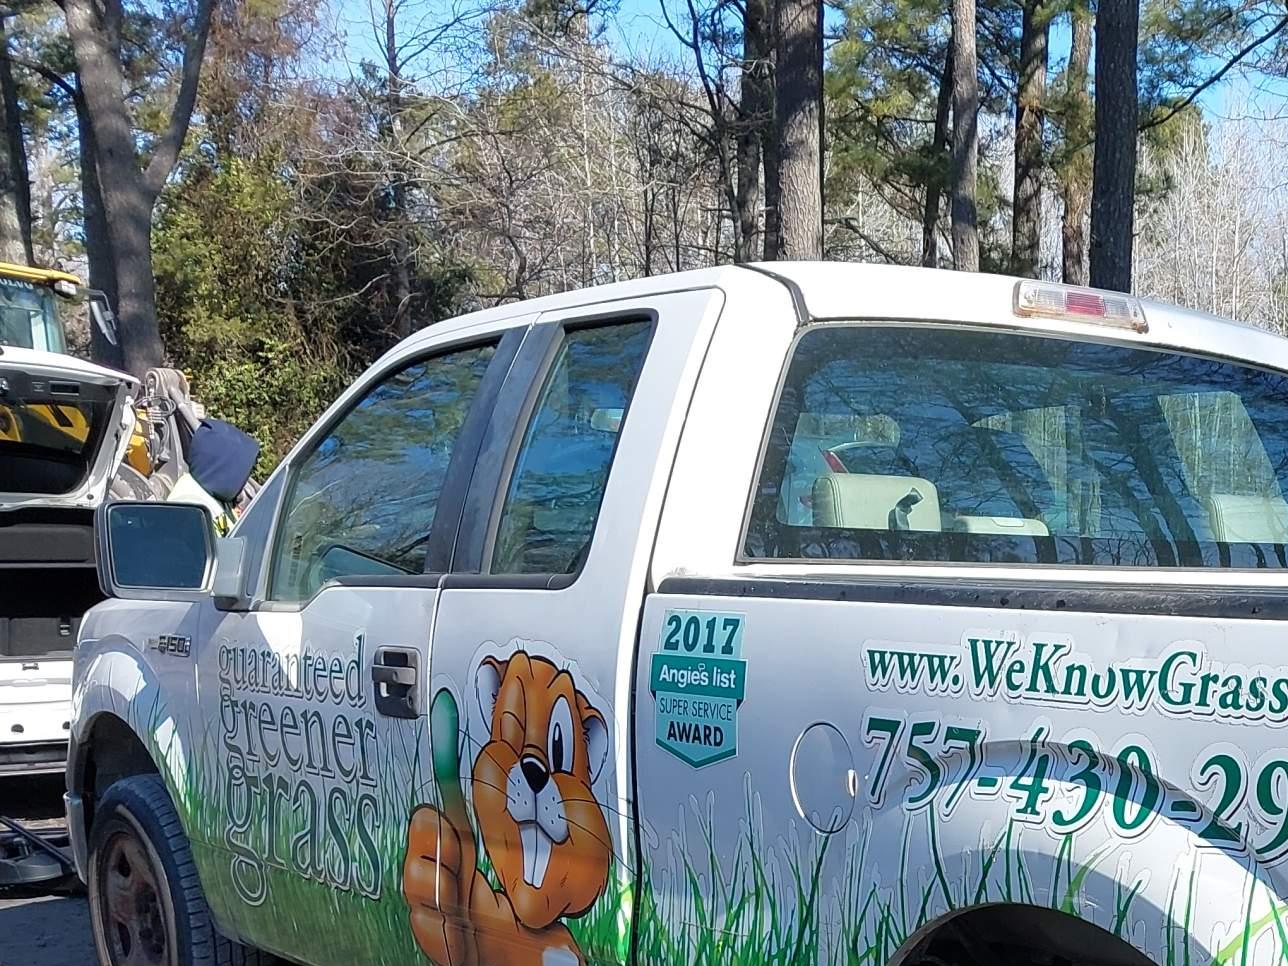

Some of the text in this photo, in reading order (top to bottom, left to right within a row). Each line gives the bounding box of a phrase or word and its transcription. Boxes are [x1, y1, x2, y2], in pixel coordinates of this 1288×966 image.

[0, 278, 34, 290] OLVO
[664, 615, 740, 655] 2017
[219, 632, 367, 706] guaranteed
[659, 663, 736, 688] Angie's list
[660, 697, 733, 721] SUPER SERVICE
[220, 693, 378, 788] greener
[667, 720, 724, 747] AWARD
[224, 765, 382, 906] grass
